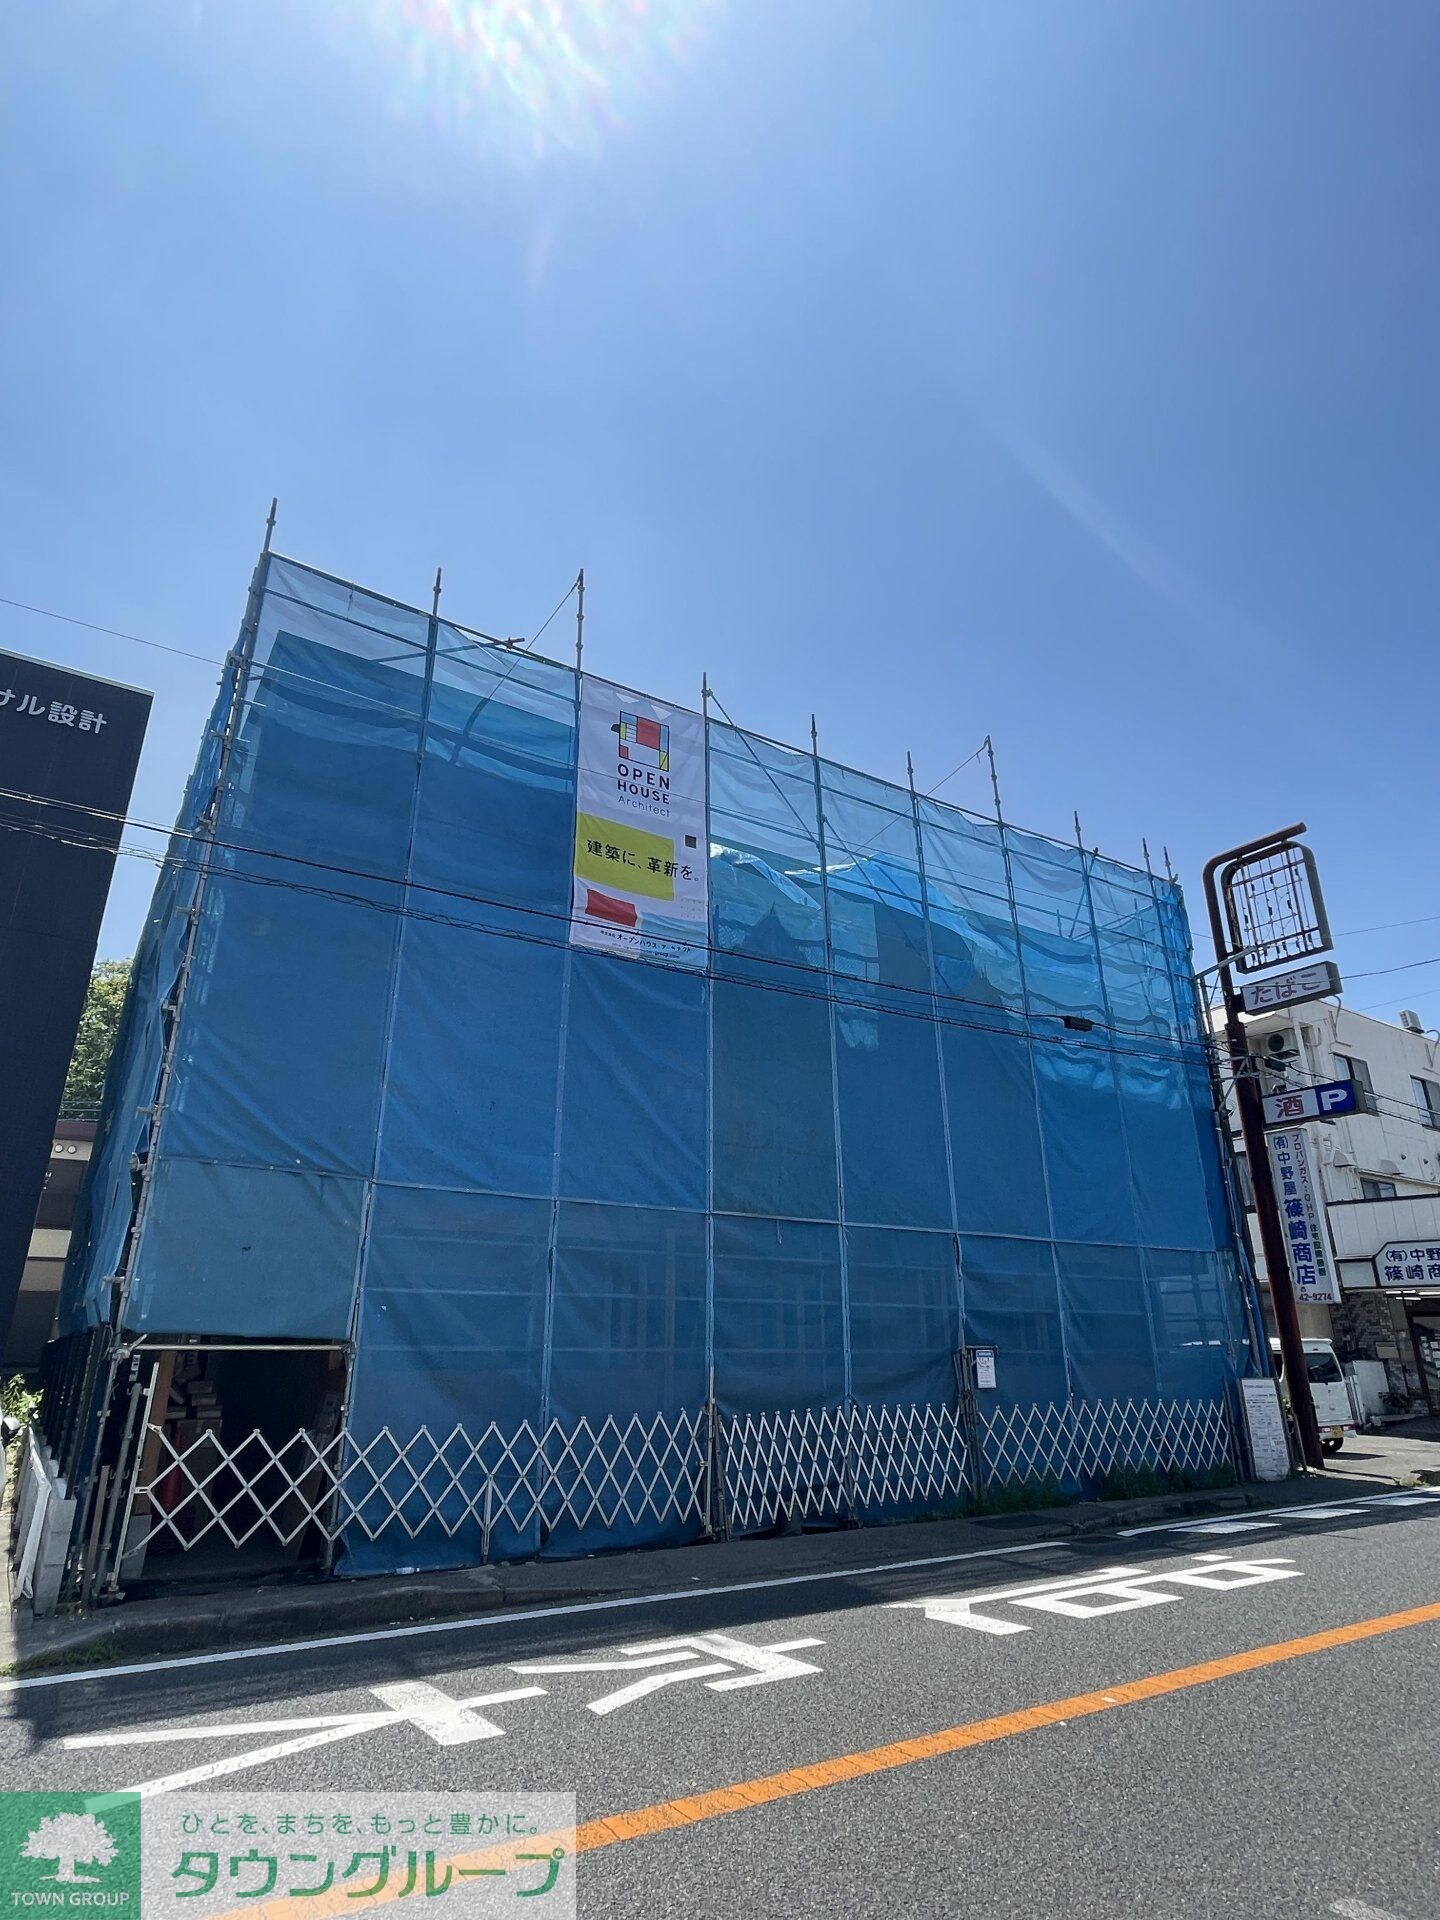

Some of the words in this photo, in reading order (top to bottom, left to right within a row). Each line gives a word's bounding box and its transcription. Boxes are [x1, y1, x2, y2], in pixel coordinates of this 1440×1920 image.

[617, 763, 670, 790] OPEN
[617, 780, 670, 805] HOUSE
[617, 795, 670, 818] Architect
[586, 839, 699, 882] 建築に、革新を。
[1250, 972, 1321, 1005] たばこ
[1274, 1095, 1305, 1119] 酒
[1320, 1088, 1348, 1111] P
[1299, 1292, 1332, 1302] 42-9274
